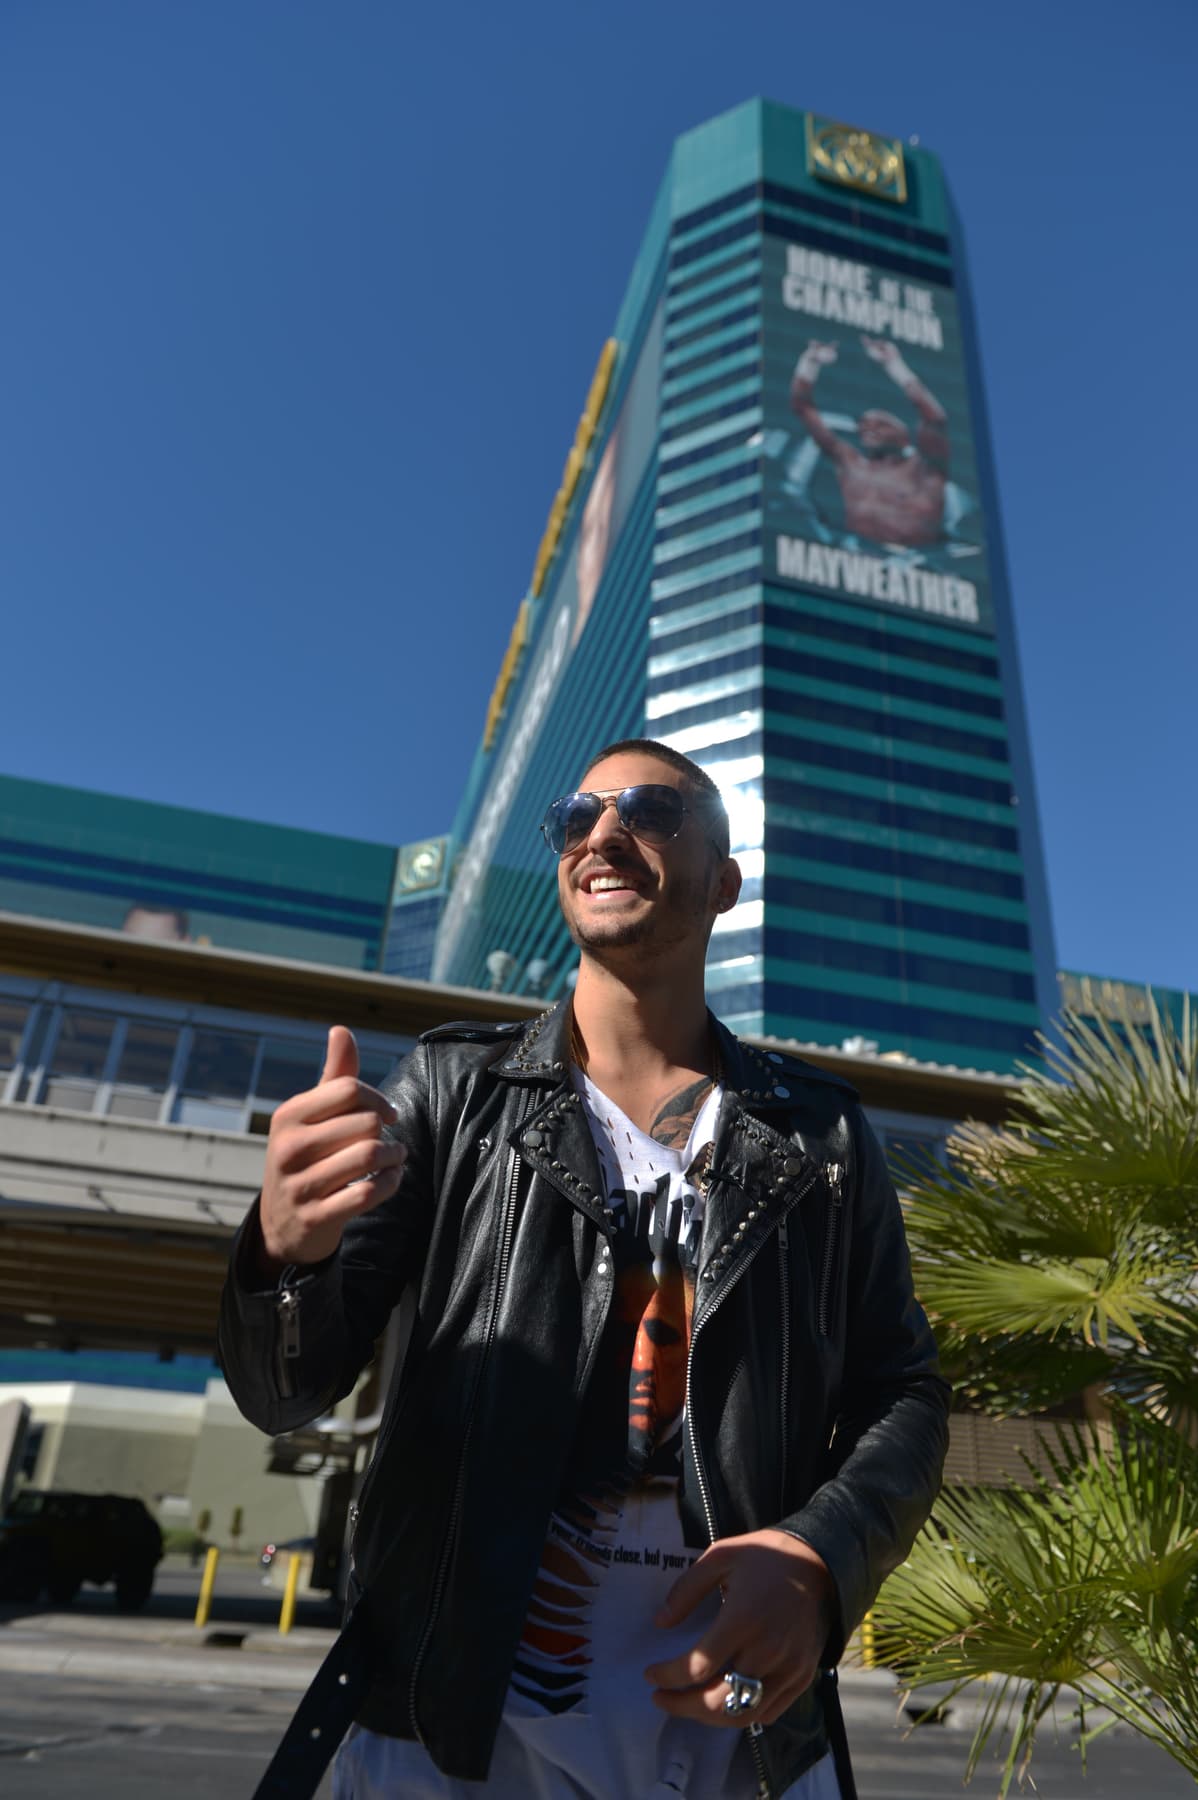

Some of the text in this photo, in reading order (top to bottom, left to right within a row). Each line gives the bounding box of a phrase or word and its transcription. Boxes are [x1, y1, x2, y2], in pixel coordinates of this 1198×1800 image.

[787, 245, 871, 296] HOME
[782, 274, 943, 351] CHAMPION
[777, 535, 979, 623] MAYWEATHER
[663, 1553, 686, 1571] your
